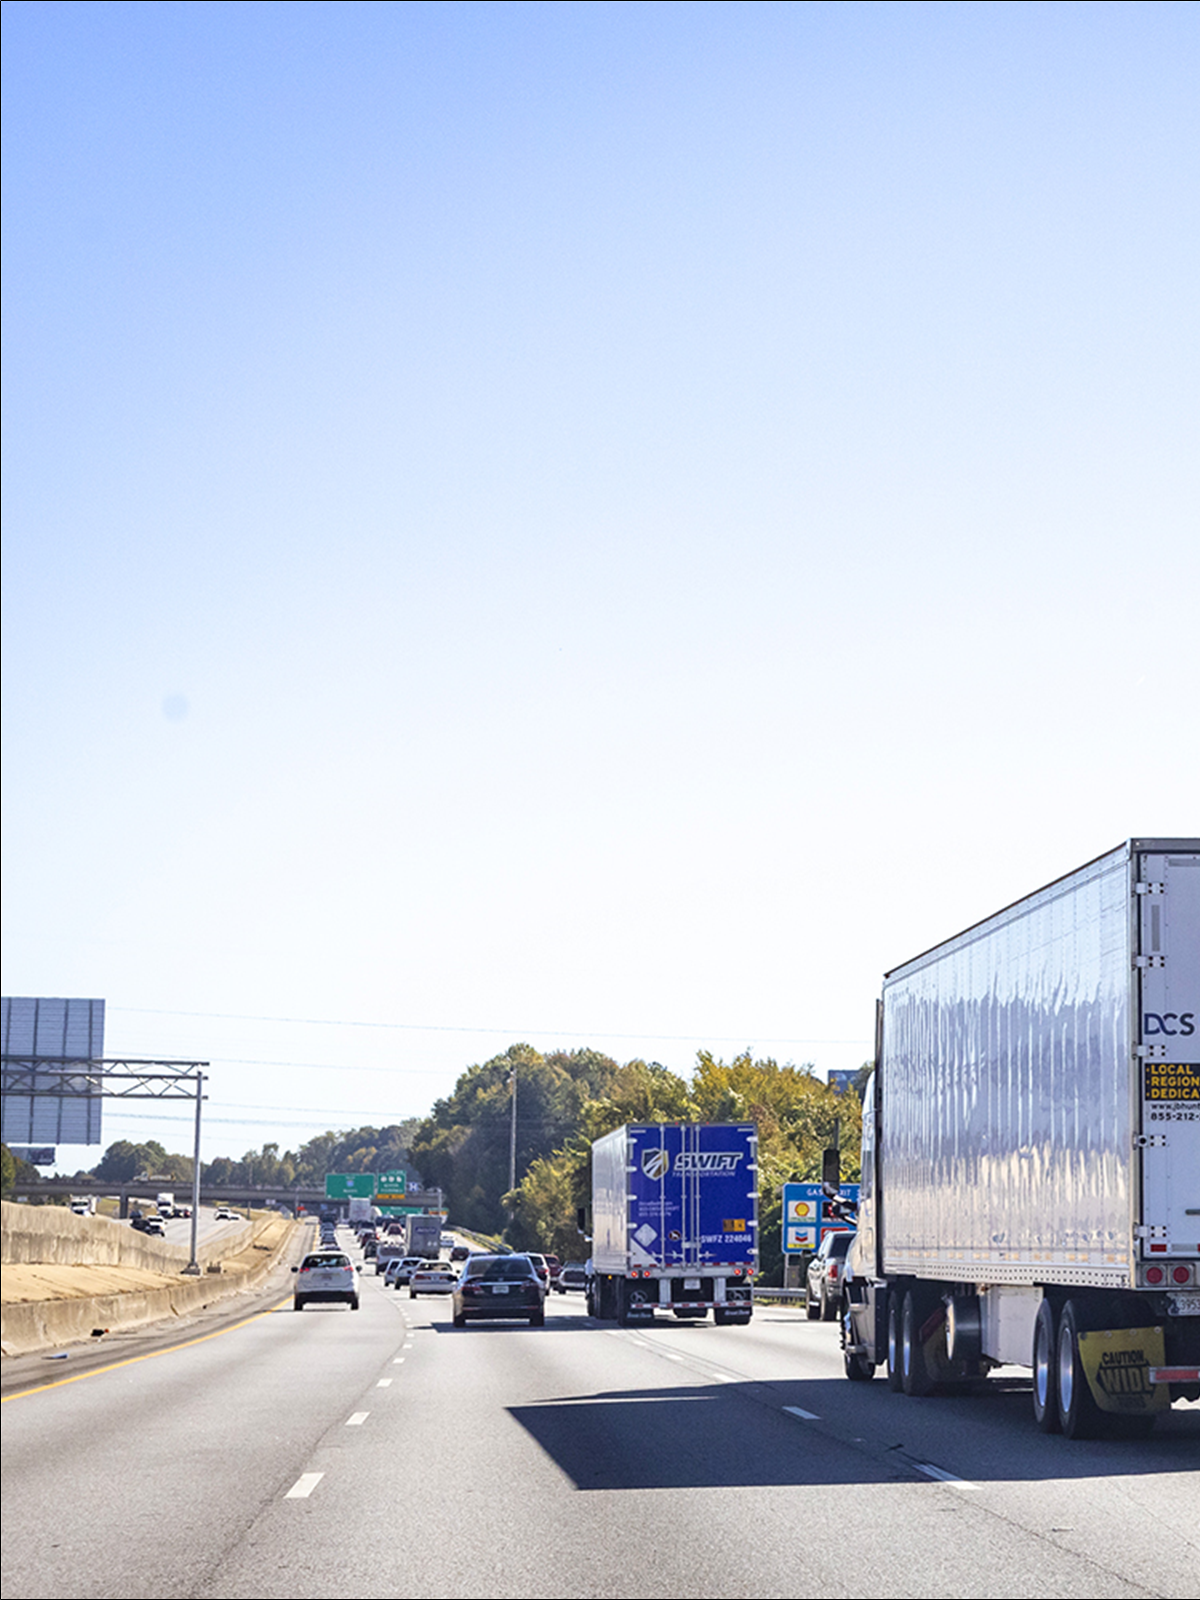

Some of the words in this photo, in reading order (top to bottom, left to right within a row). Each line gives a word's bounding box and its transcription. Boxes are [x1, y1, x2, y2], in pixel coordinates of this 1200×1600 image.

[1144, 1013, 1195, 1035] DCS
[1151, 1065, 1193, 1074] LOCAL
[673, 1152, 744, 1171] SWIFT
[1102, 1350, 1145, 1365] CAUTION
